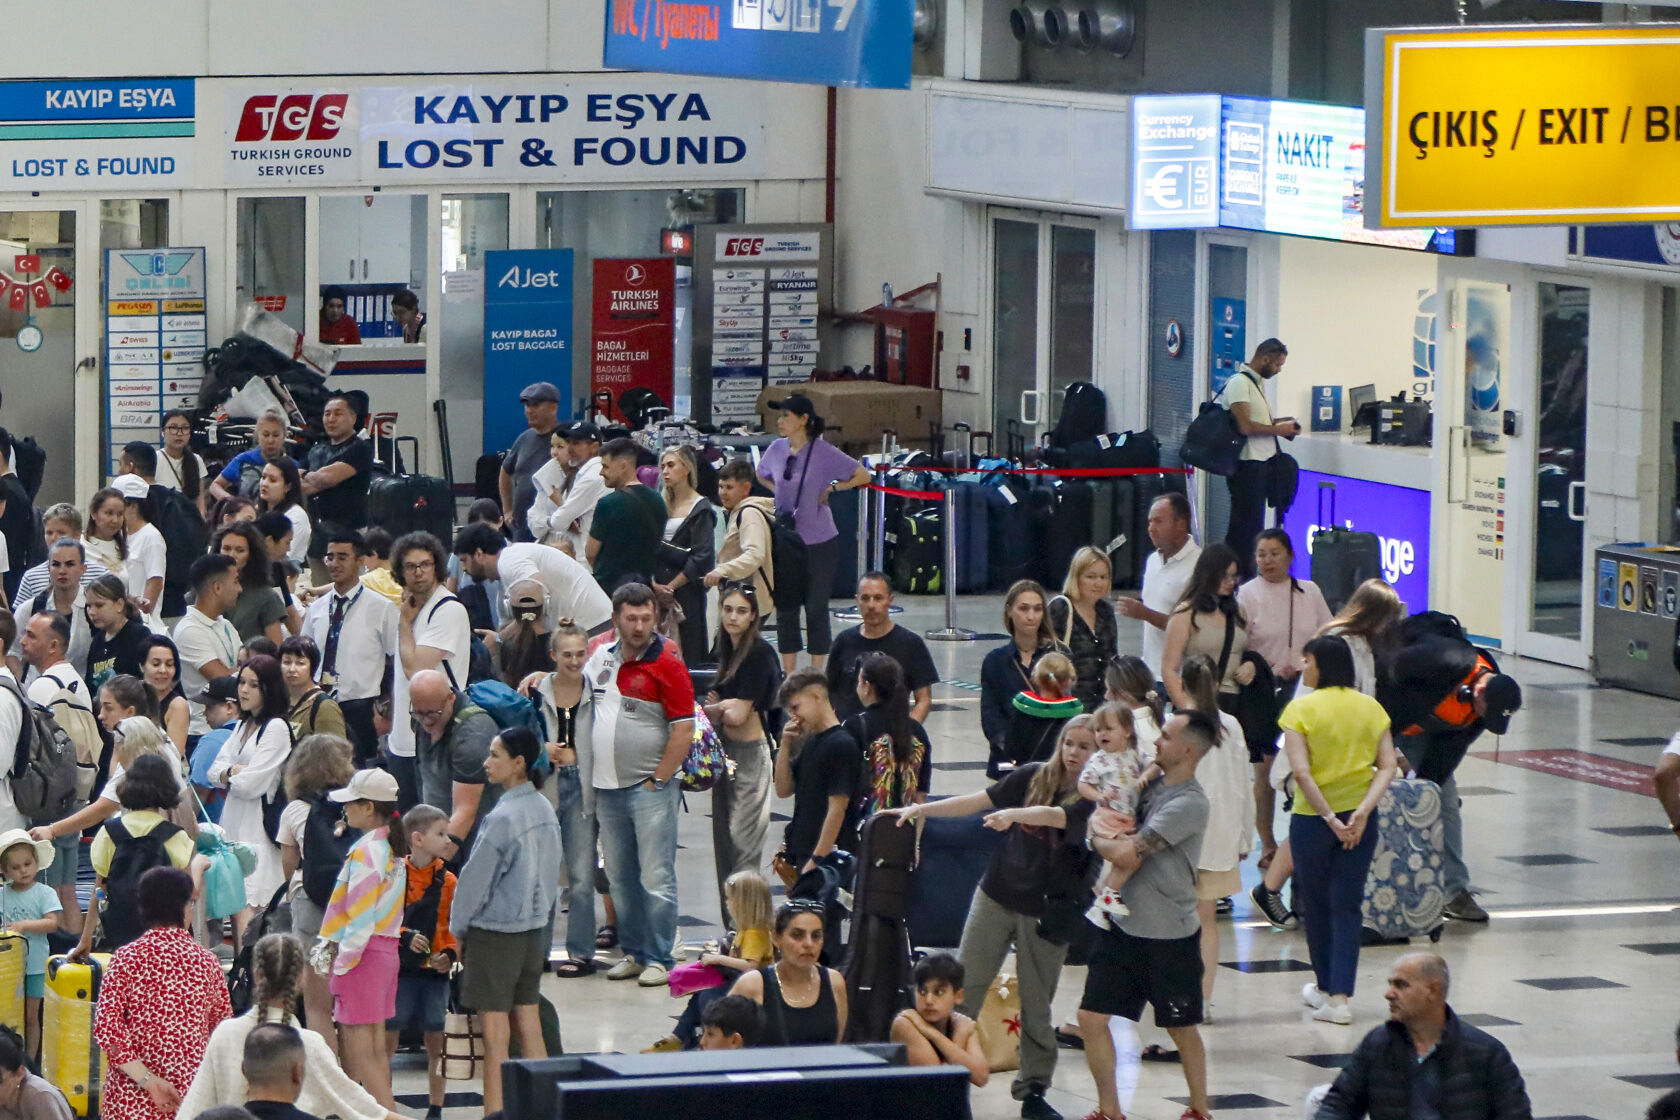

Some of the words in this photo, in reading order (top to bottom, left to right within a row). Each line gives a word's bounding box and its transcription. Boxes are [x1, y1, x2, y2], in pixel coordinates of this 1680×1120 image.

[46, 89, 112, 109] KAYIP
[120, 88, 176, 112] EŞYA
[414, 95, 570, 125] KAYIP
[586, 93, 711, 129] EŞYA
[1138, 113, 1194, 128] Currency
[1138, 126, 1218, 142] Exchange
[1409, 110, 1498, 160] ÇIKIŞ
[1539, 107, 1609, 145] EXIT
[231, 148, 291, 160] TURKISH
[294, 147, 352, 159] GROUND
[378, 138, 504, 169] LOST
[519, 137, 554, 166] &
[574, 136, 748, 165] FOUND
[13, 158, 67, 177] LOST
[75, 158, 89, 176] &
[98, 157, 175, 175] FOUND
[258, 164, 326, 176] SERVICES
[1194, 166, 1210, 206] EUR
[612, 290, 659, 300] TURKISH
[610, 300, 659, 311] AIRLINES
[491, 331, 522, 339] KAYIP
[524, 329, 558, 339] BAGAJ
[491, 341, 517, 350] LOST
[518, 339, 565, 350] BAGGAGE
[597, 341, 626, 351] BAGAJ
